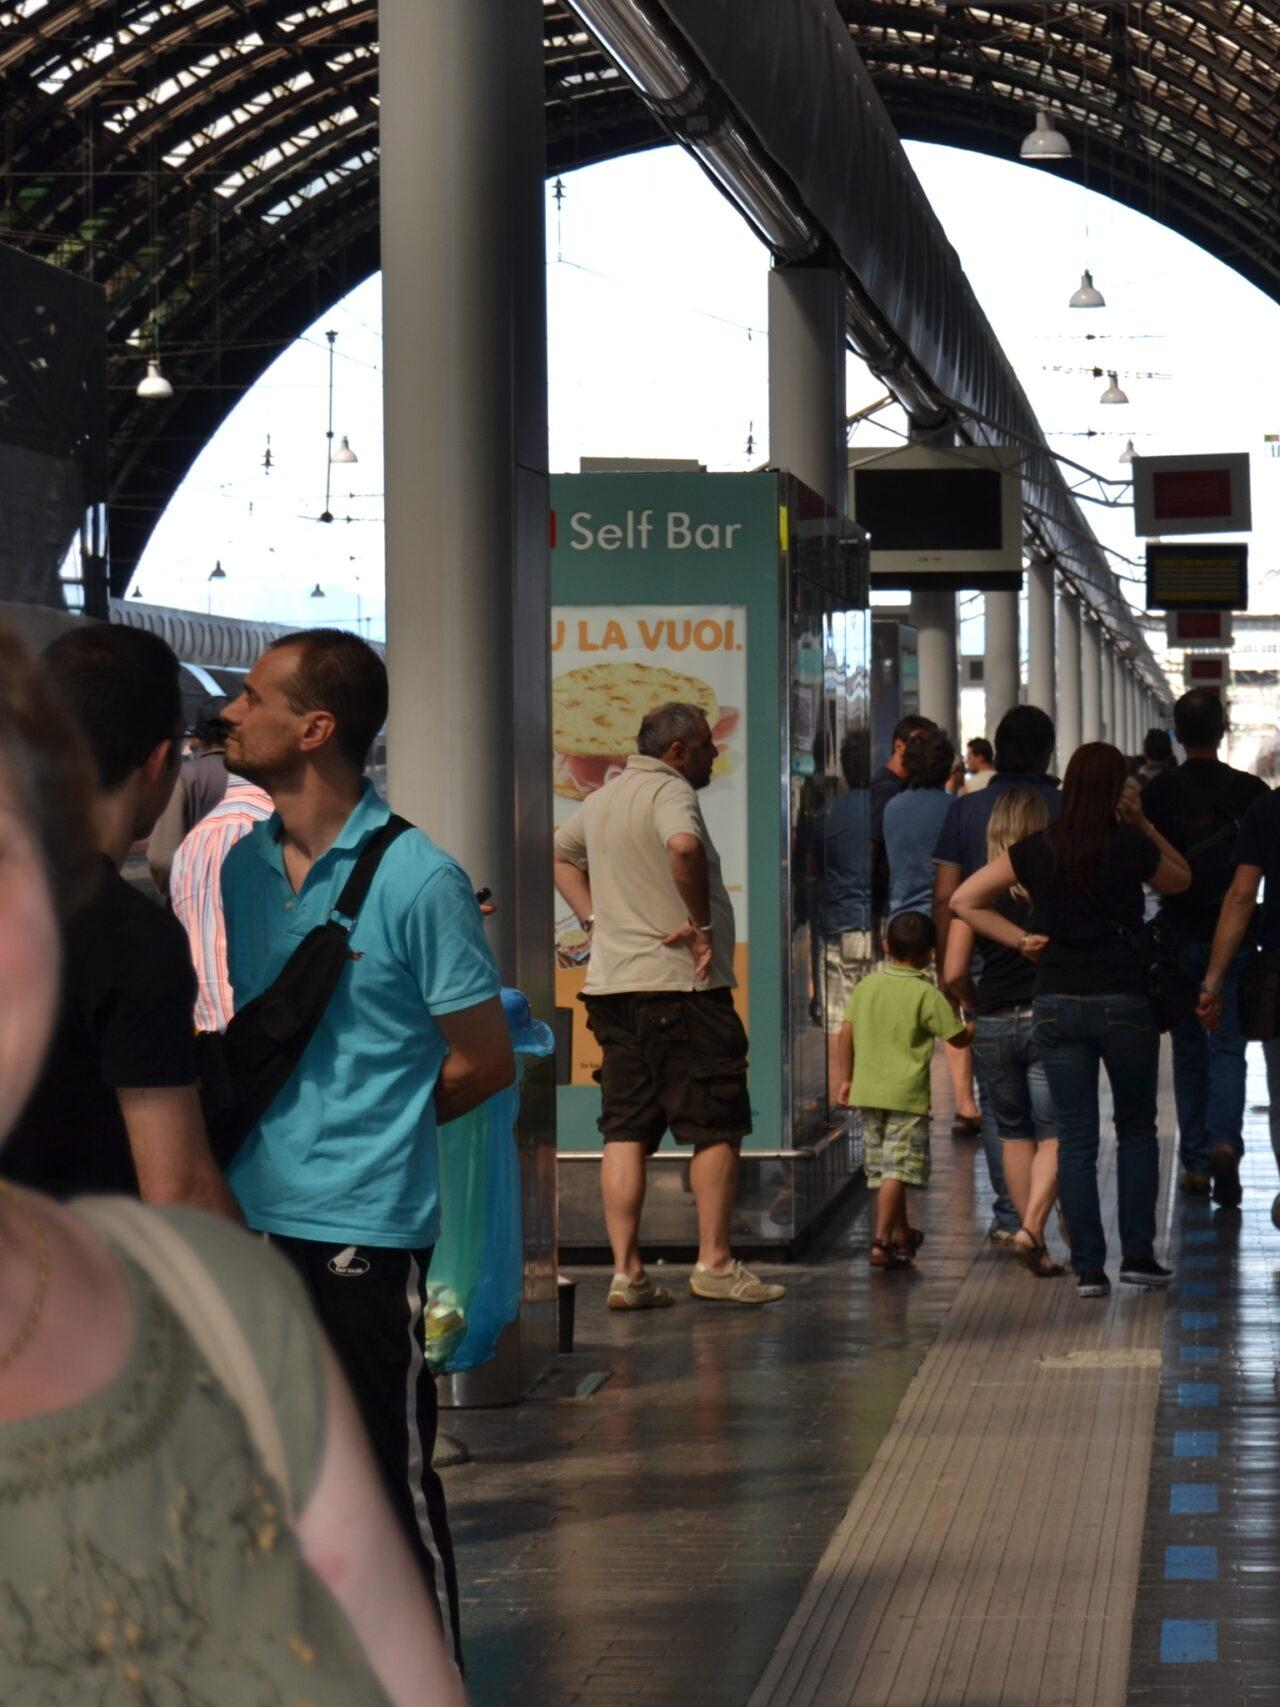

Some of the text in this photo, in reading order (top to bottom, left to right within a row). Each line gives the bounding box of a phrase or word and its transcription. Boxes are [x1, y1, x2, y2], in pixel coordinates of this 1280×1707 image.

[570, 509, 742, 550] Self Bar
[578, 620, 628, 651] LA
[638, 620, 743, 651] VUOI.
